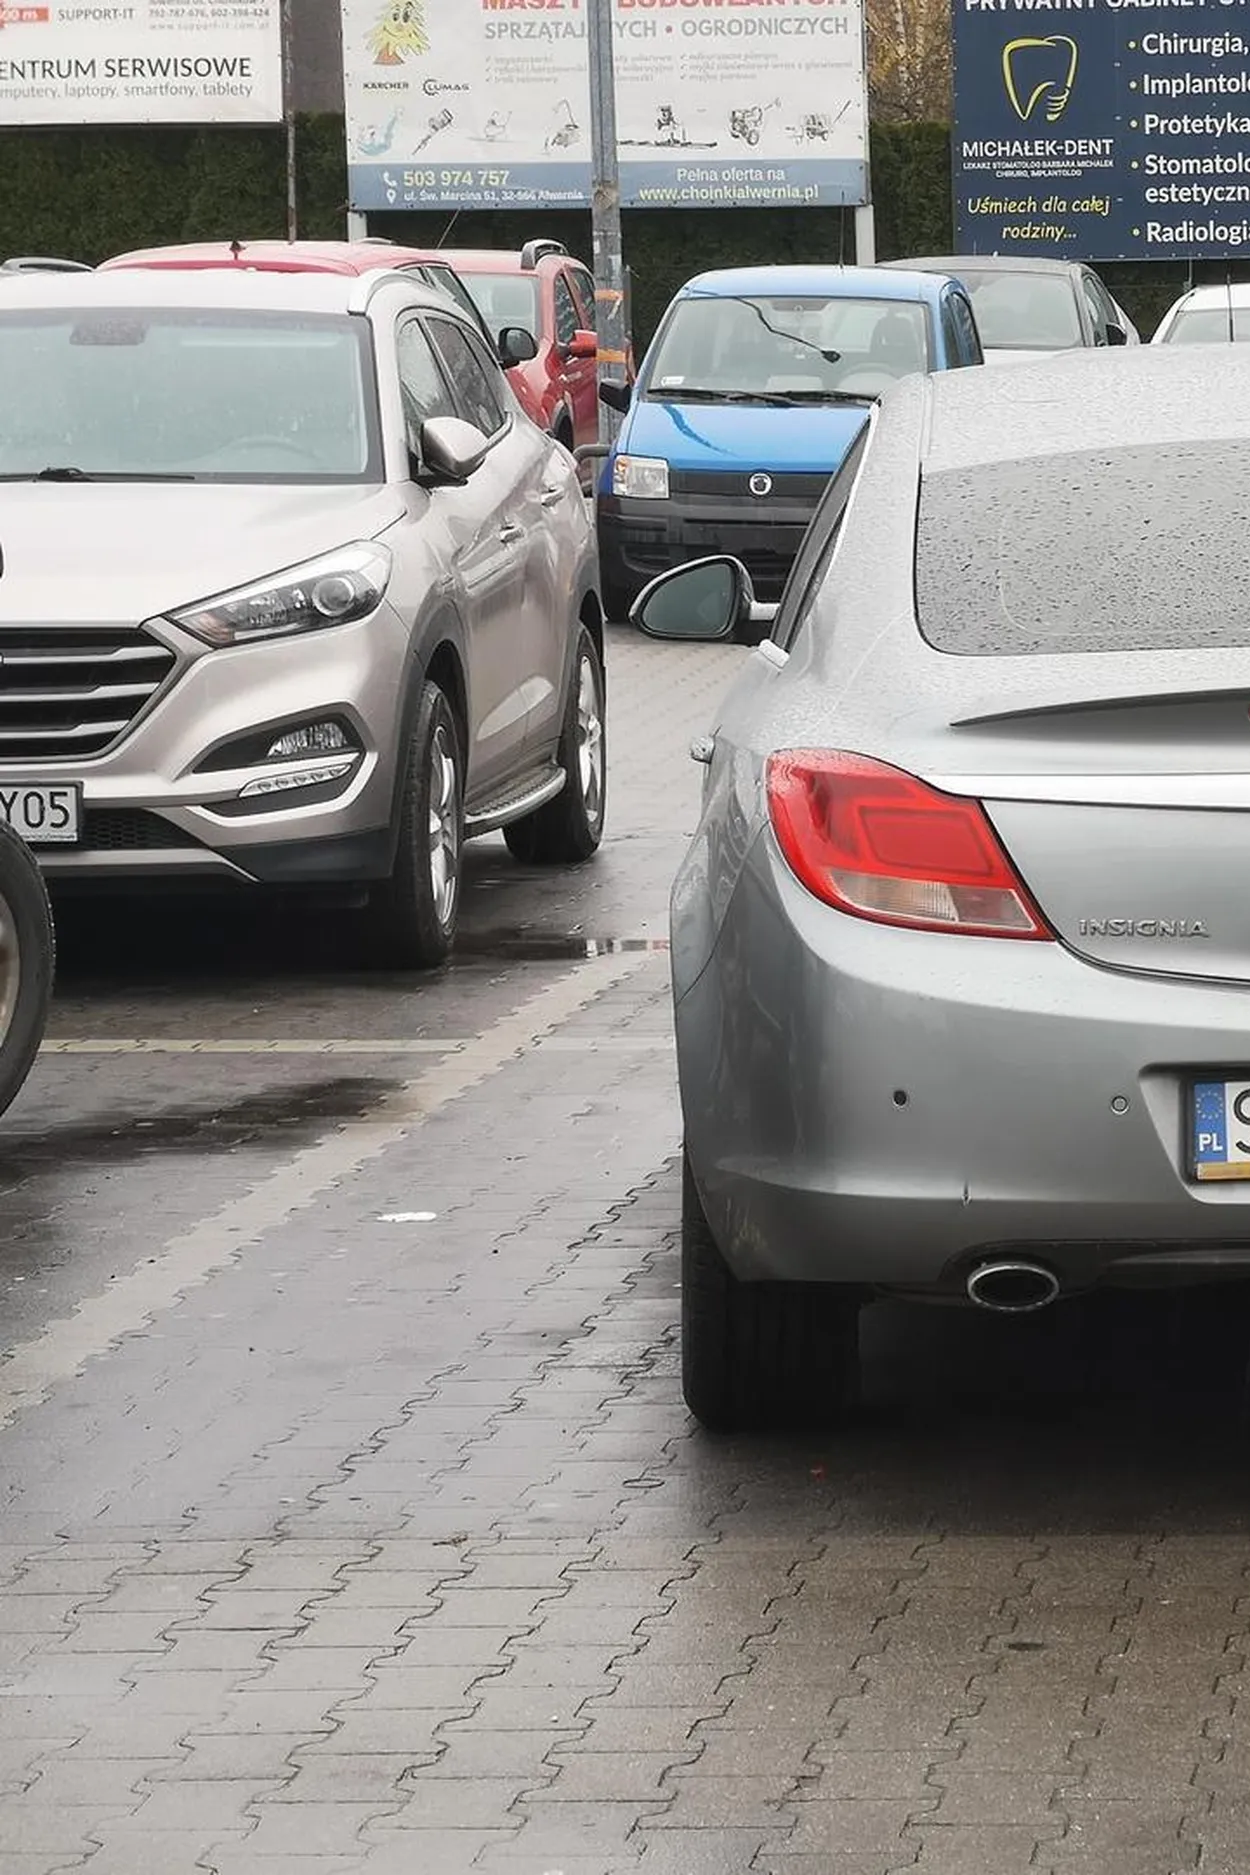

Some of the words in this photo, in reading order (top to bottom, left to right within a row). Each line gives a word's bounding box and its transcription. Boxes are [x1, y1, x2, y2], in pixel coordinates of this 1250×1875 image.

[57, 8, 136, 20] SUPPORT-IT
[485, 18, 657, 44] SPRZĄTAJYCH
[681, 18, 848, 37] OGRODNICZYCH
[1142, 32, 1249, 57] Chirurgia,
[103, 57, 252, 78] SERWISOWE
[65, 83, 119, 98] laptopy,
[123, 82, 197, 97] smartfony,
[203, 82, 253, 98] tablety
[962, 140, 1114, 157] MICHAŁEK-DENT
[403, 171, 436, 186] 503
[440, 171, 474, 186] 974
[478, 170, 511, 185] 757
[722, 167, 761, 181] oferta
[766, 169, 785, 181] na
[639, 184, 819, 201] www.choinkialwernia.pl
[967, 197, 1037, 214] Uśmiech
[1042, 196, 1067, 213] dla
[1072, 196, 1110, 216] całej
[1002, 222, 1077, 242] rodziny...
[0, 791, 70, 828] Y05
[1079, 919, 1211, 938] INSIGNIA
[1198, 1132, 1224, 1152] PL
